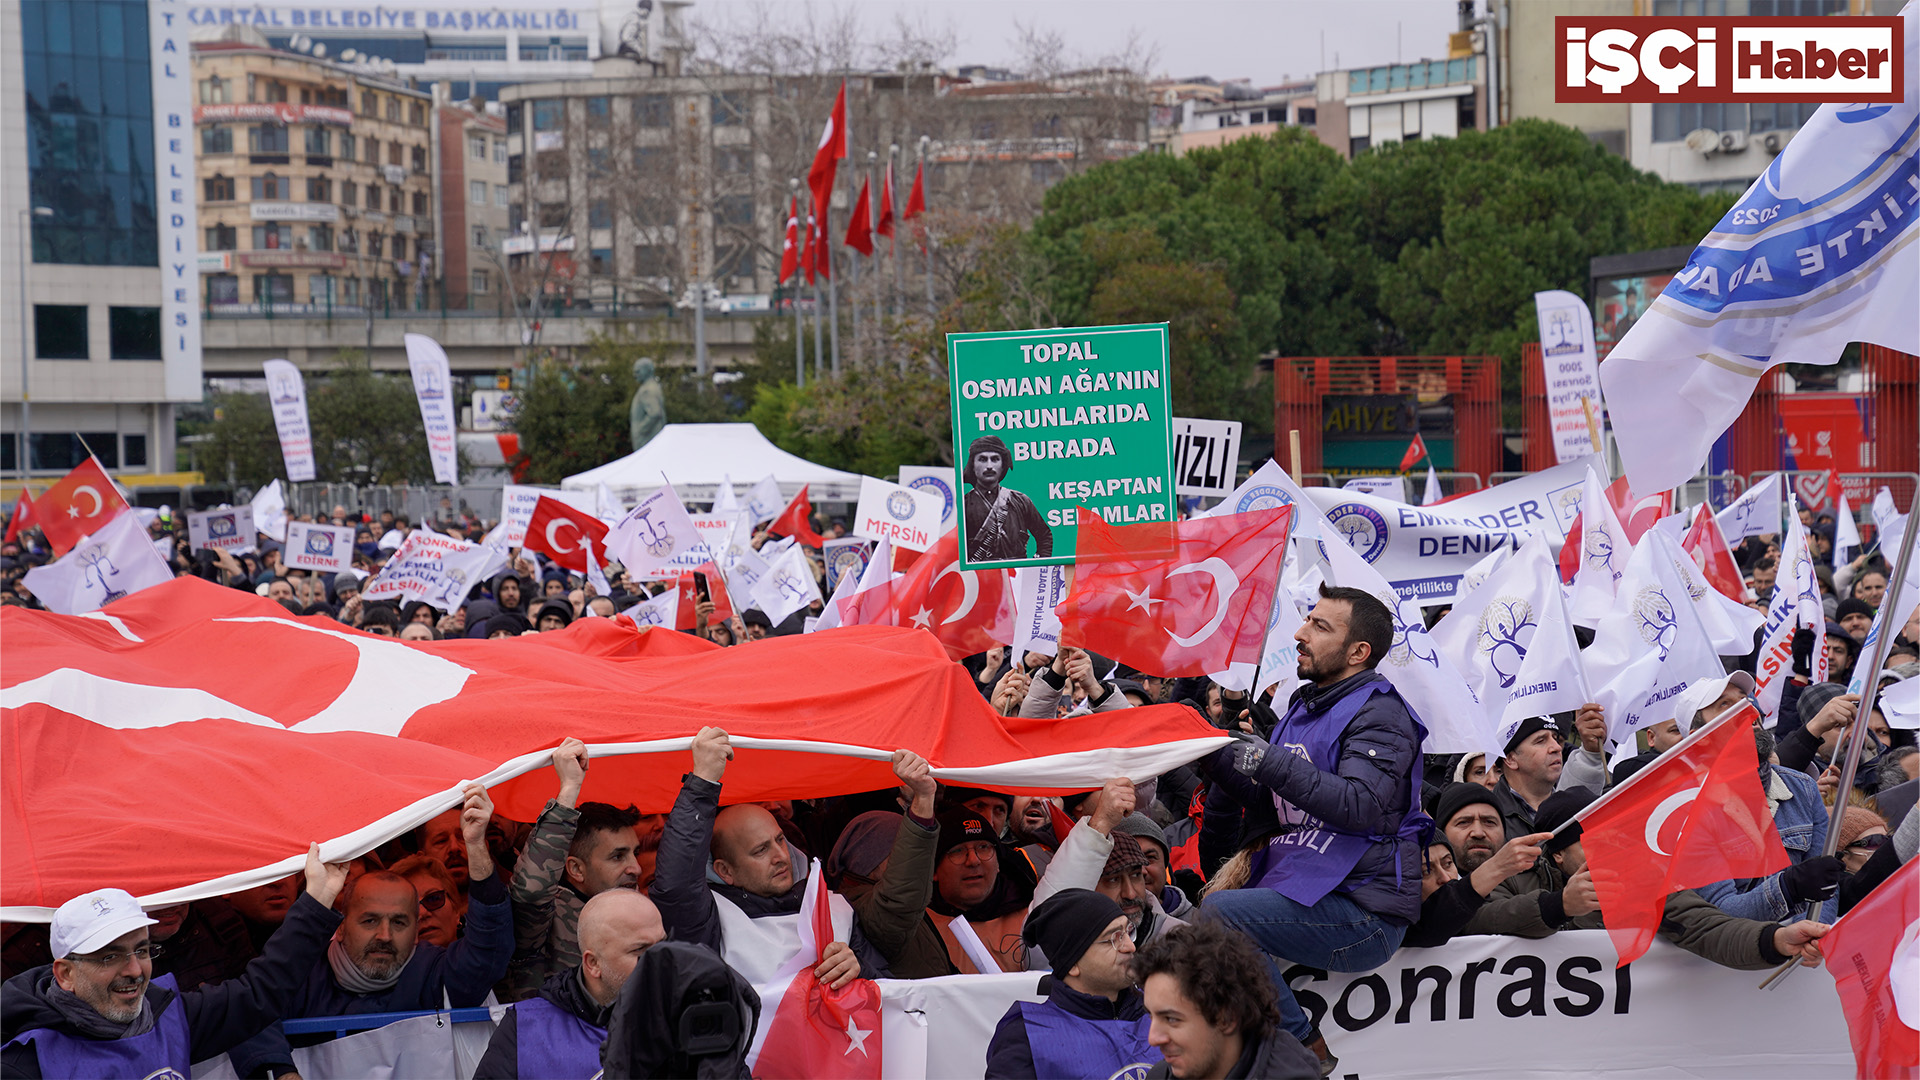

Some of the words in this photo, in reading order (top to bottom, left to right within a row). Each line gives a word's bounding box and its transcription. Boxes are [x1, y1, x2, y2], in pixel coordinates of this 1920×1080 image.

[291, 6, 415, 27] BELEDİYE
[425, 9, 578, 31] BAŞKANLIĞI
[162, 0, 176, 78] TAL
[168, 114, 187, 351] BELEDİYESİ
[1020, 341, 1099, 364] TOPAL
[962, 375, 1052, 400] OSMAN
[1059, 368, 1160, 394] AĞA'NIN
[975, 402, 1151, 431] TORUNLARIDA
[1323, 403, 1397, 432] AHVE
[1013, 437, 1116, 461] BURADA
[1048, 476, 1162, 503] KEŞAPTAN
[203, 536, 245, 549] EDİRNE
[866, 518, 928, 546] MERSİN
[297, 555, 339, 568] EDİRNE
[1393, 581, 1453, 596] meklilikte
